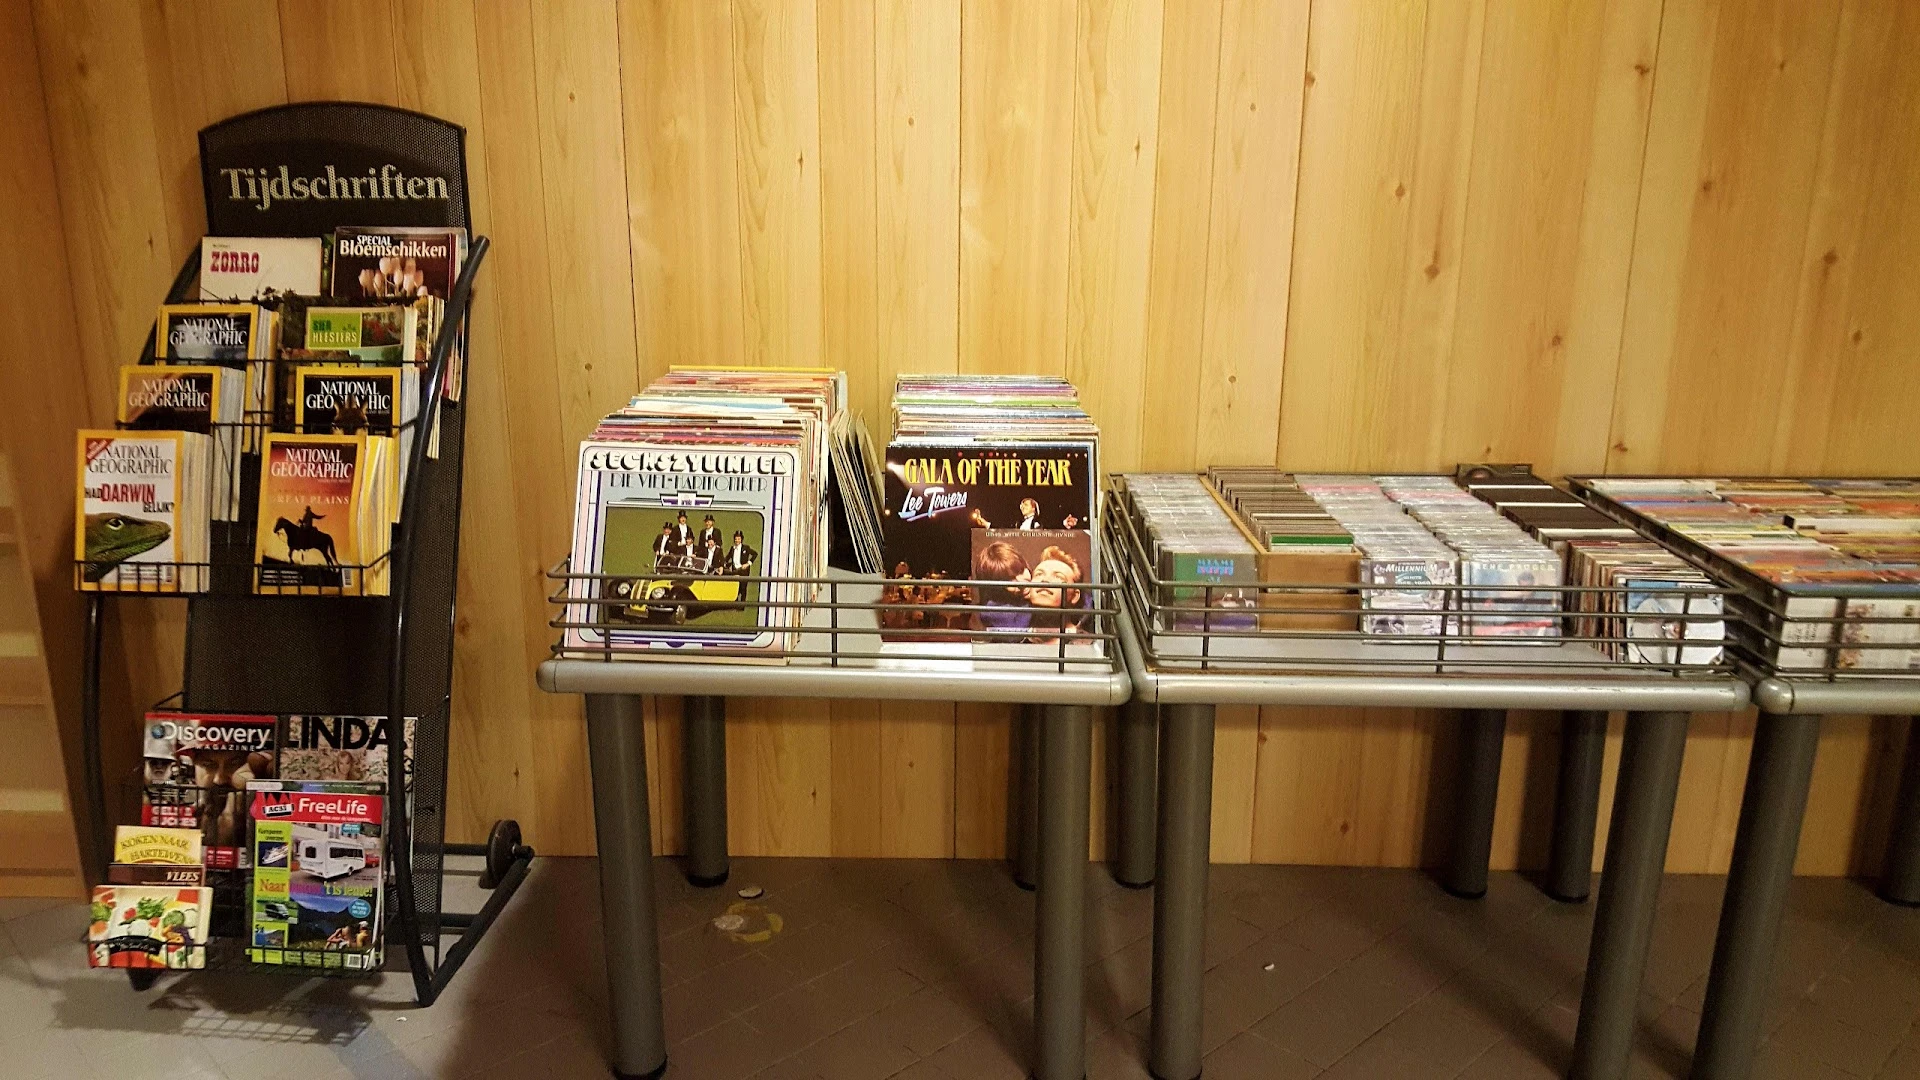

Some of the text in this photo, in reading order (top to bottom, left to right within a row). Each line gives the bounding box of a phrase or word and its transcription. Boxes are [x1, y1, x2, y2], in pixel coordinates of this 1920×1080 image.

[220, 163, 451, 211] Tijdschriften
[339, 239, 447, 257] Bloemschikken
[356, 234, 392, 246] SPECIAL
[210, 251, 259, 273] ZORRO
[183, 318, 236, 332] NATIONAL
[312, 331, 358, 344] HEESTERS
[141, 377, 199, 393] NATIONAL
[320, 380, 380, 395] NATIONAL
[128, 390, 210, 408] GEOGRAPHIC
[305, 394, 391, 410] GEOHIC
[103, 445, 160, 459] NATIONAL
[285, 448, 342, 463] NATIONAL
[89, 458, 173, 474] GEOGRAPHIC
[271, 461, 353, 479] GEOGRAPHIC
[904, 458, 1073, 486] GALA OF THE YEAR
[610, 473, 768, 492] DIE VIEL-HARMONIKER
[101, 483, 156, 504] DARWIN
[310, 494, 349, 505] PLAINS
[899, 486, 968, 519] Lee Towers
[1385, 563, 1437, 573] MILLENNIUM
[161, 721, 271, 749] Discovery
[194, 743, 256, 752] MAGAZINE
[298, 798, 368, 815] FreeLife
[166, 871, 200, 882] VLEES
[260, 878, 286, 893] Naar
